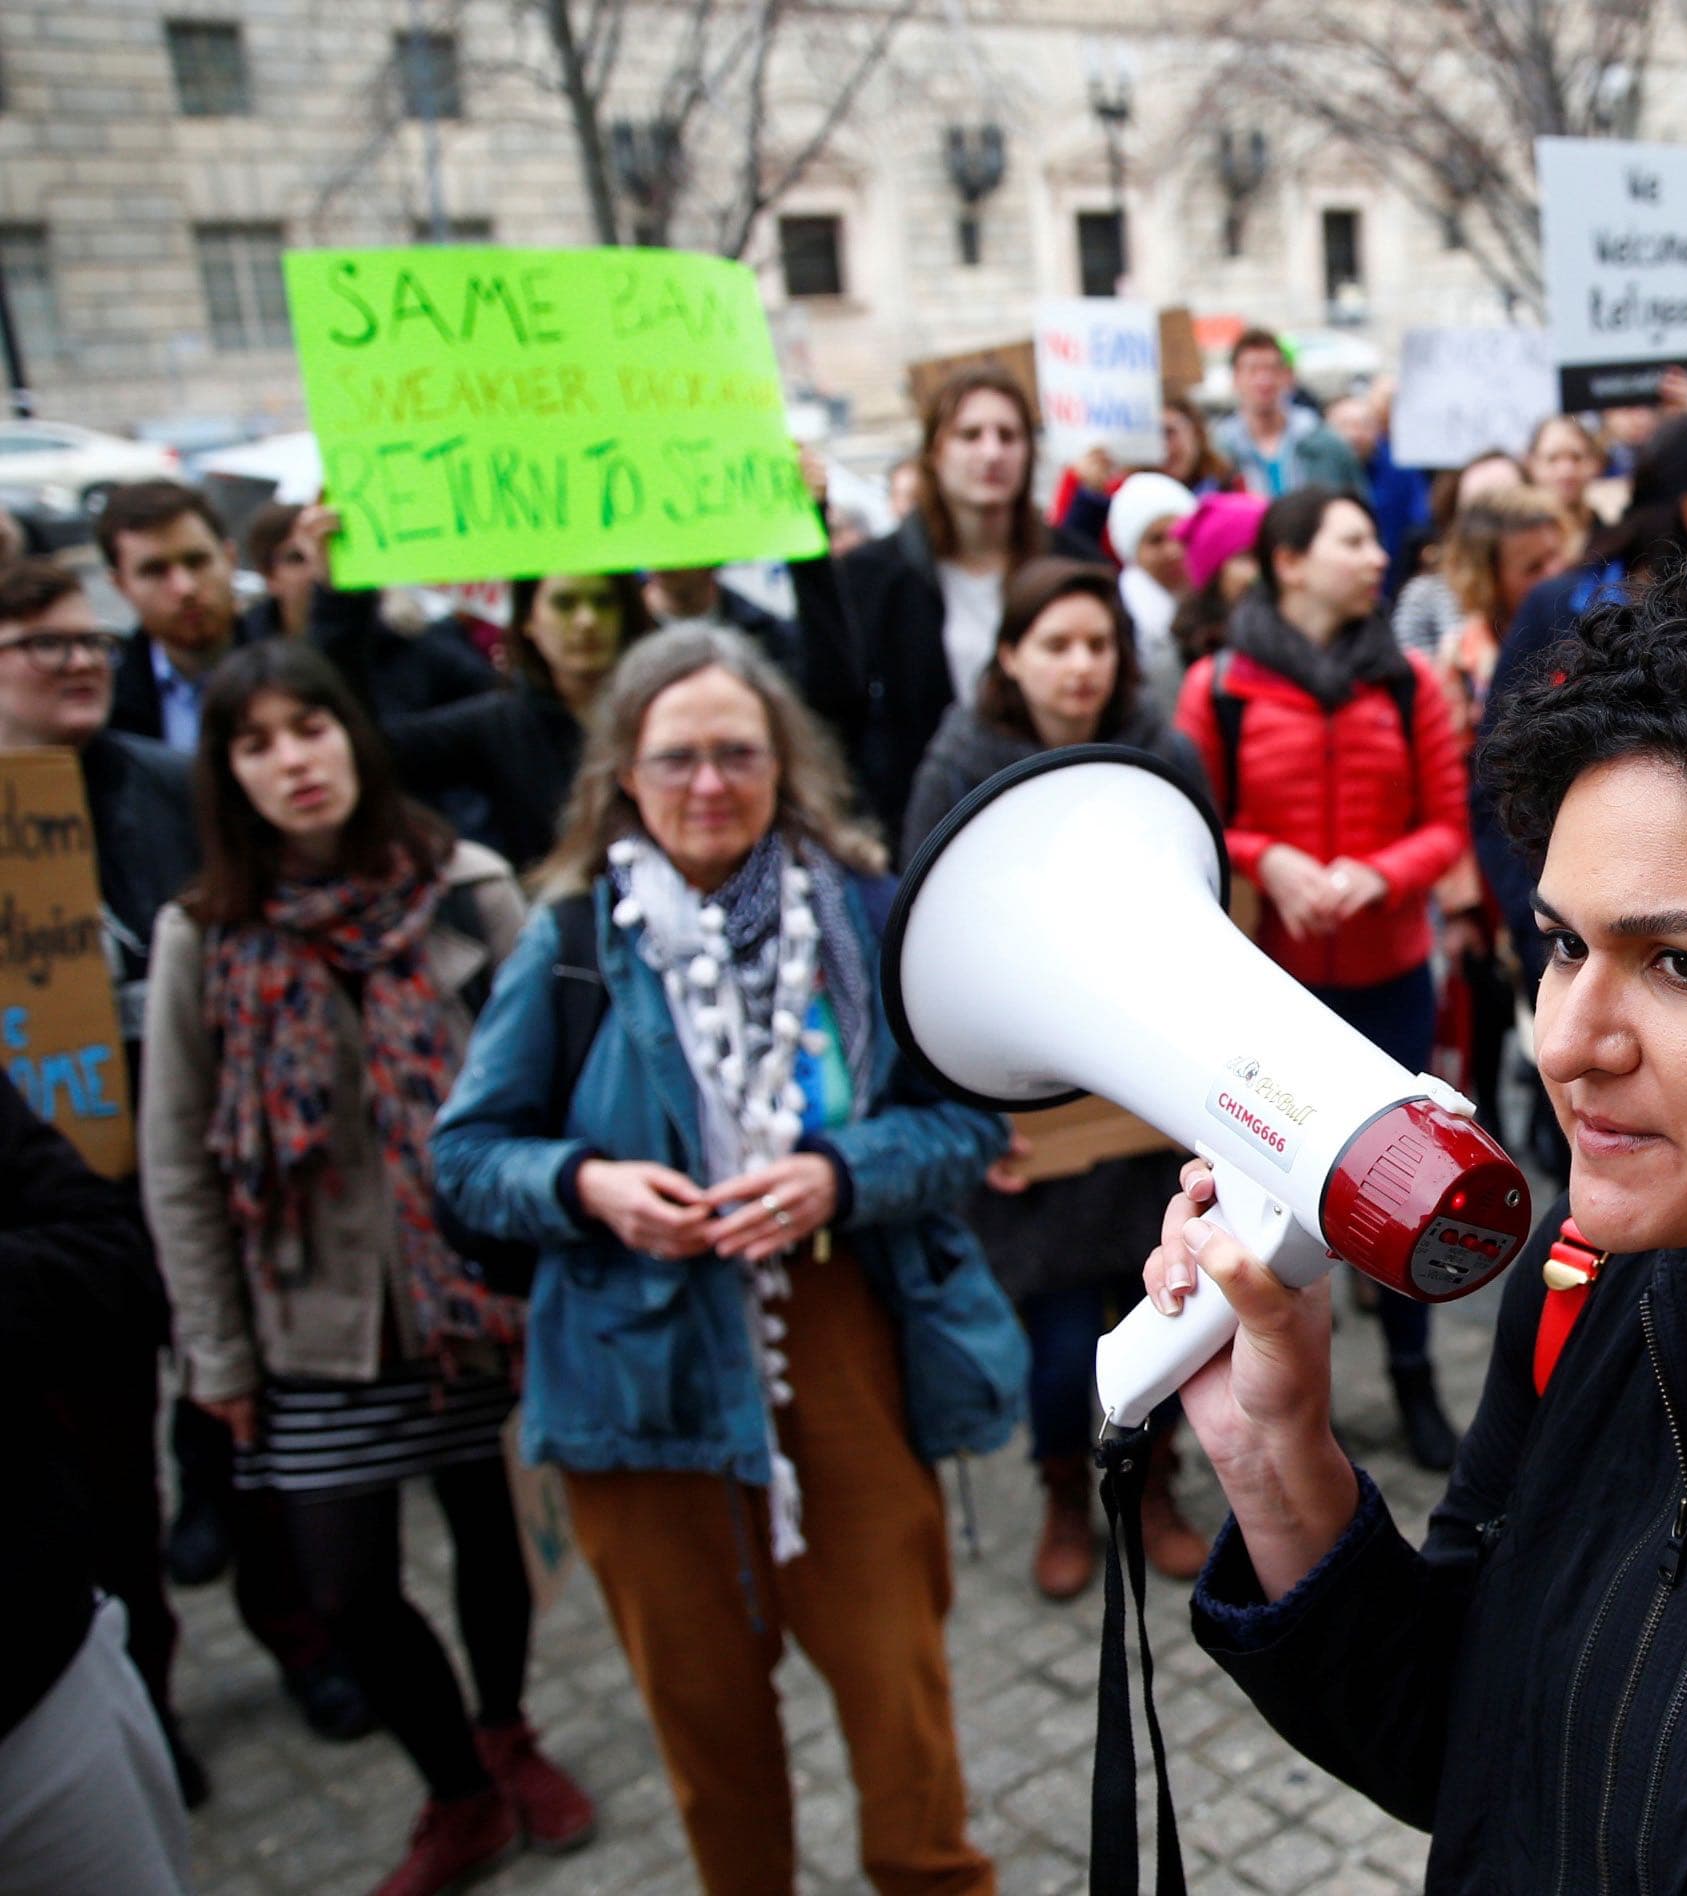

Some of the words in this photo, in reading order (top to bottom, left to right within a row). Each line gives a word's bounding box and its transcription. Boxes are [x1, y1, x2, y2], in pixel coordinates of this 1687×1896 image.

[328, 260, 562, 347] SAME
[610, 266, 740, 339] BAN
[328, 435, 570, 551] RETURN
[583, 438, 645, 530] TO
[1218, 1092, 1287, 1153] CHIMG666
